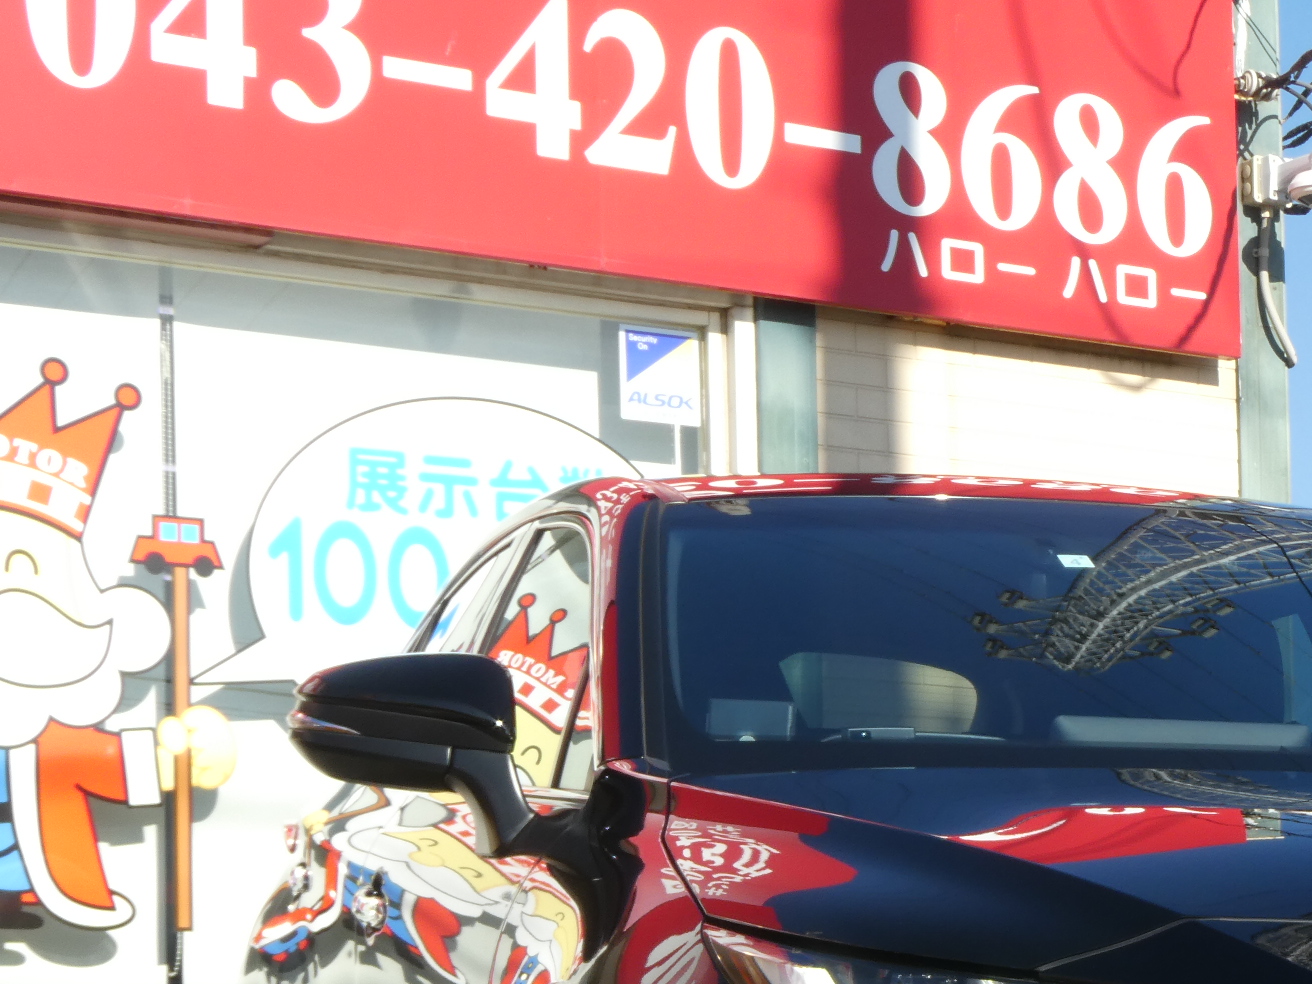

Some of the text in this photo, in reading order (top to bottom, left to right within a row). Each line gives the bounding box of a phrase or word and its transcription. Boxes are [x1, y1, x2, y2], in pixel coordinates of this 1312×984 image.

[881, 228, 1207, 309] ハロー ハロー
[629, 333, 658, 344] Security
[637, 342, 648, 350] On
[628, 391, 694, 410] ALSOK
[346, 447, 604, 521] 展示台
